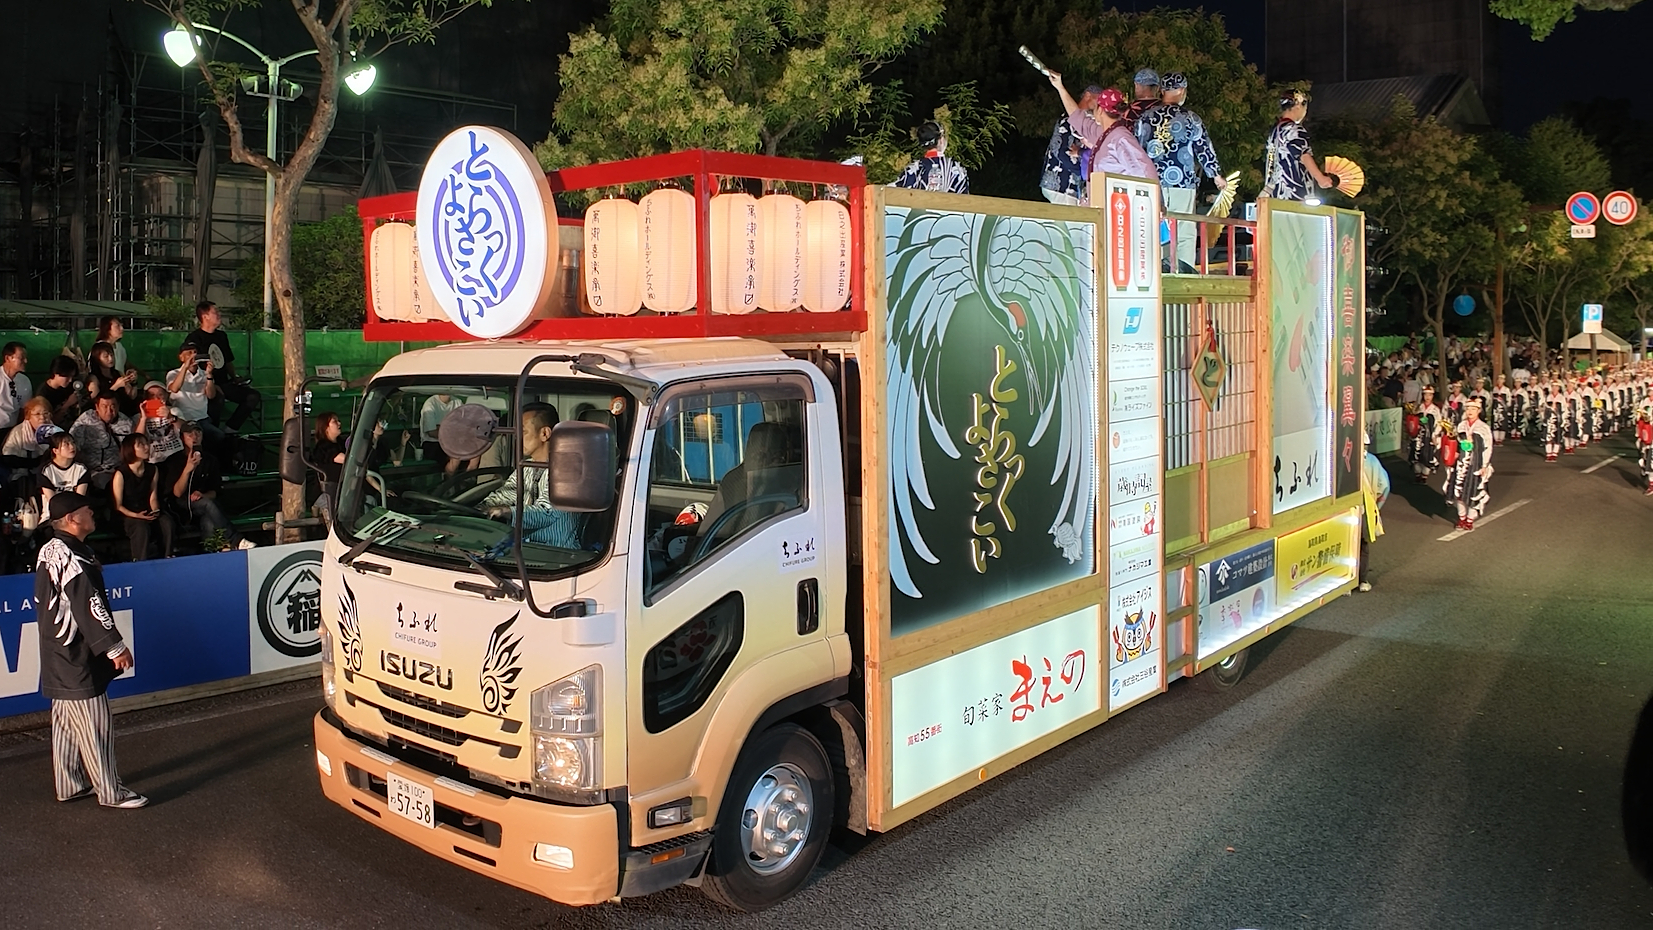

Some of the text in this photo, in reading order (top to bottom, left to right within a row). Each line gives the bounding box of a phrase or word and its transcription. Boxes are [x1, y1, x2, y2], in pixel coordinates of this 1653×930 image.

[465, 131, 504, 298] とらっく
[1611, 201, 1628, 214] 40
[445, 173, 485, 327] よさこい
[1588, 306, 1599, 320] P
[989, 344, 1025, 532] とらっく
[965, 393, 1002, 574] よさこい
[1273, 449, 1319, 502] ちふれ
[781, 537, 815, 558] ちふれ
[396, 601, 438, 633] ちふれ
[394, 632, 437, 648] CHIFURE GROUP
[380, 649, 453, 691] ISUZU
[1010, 650, 1085, 723] まえの
[962, 693, 1004, 726] 旬菜家
